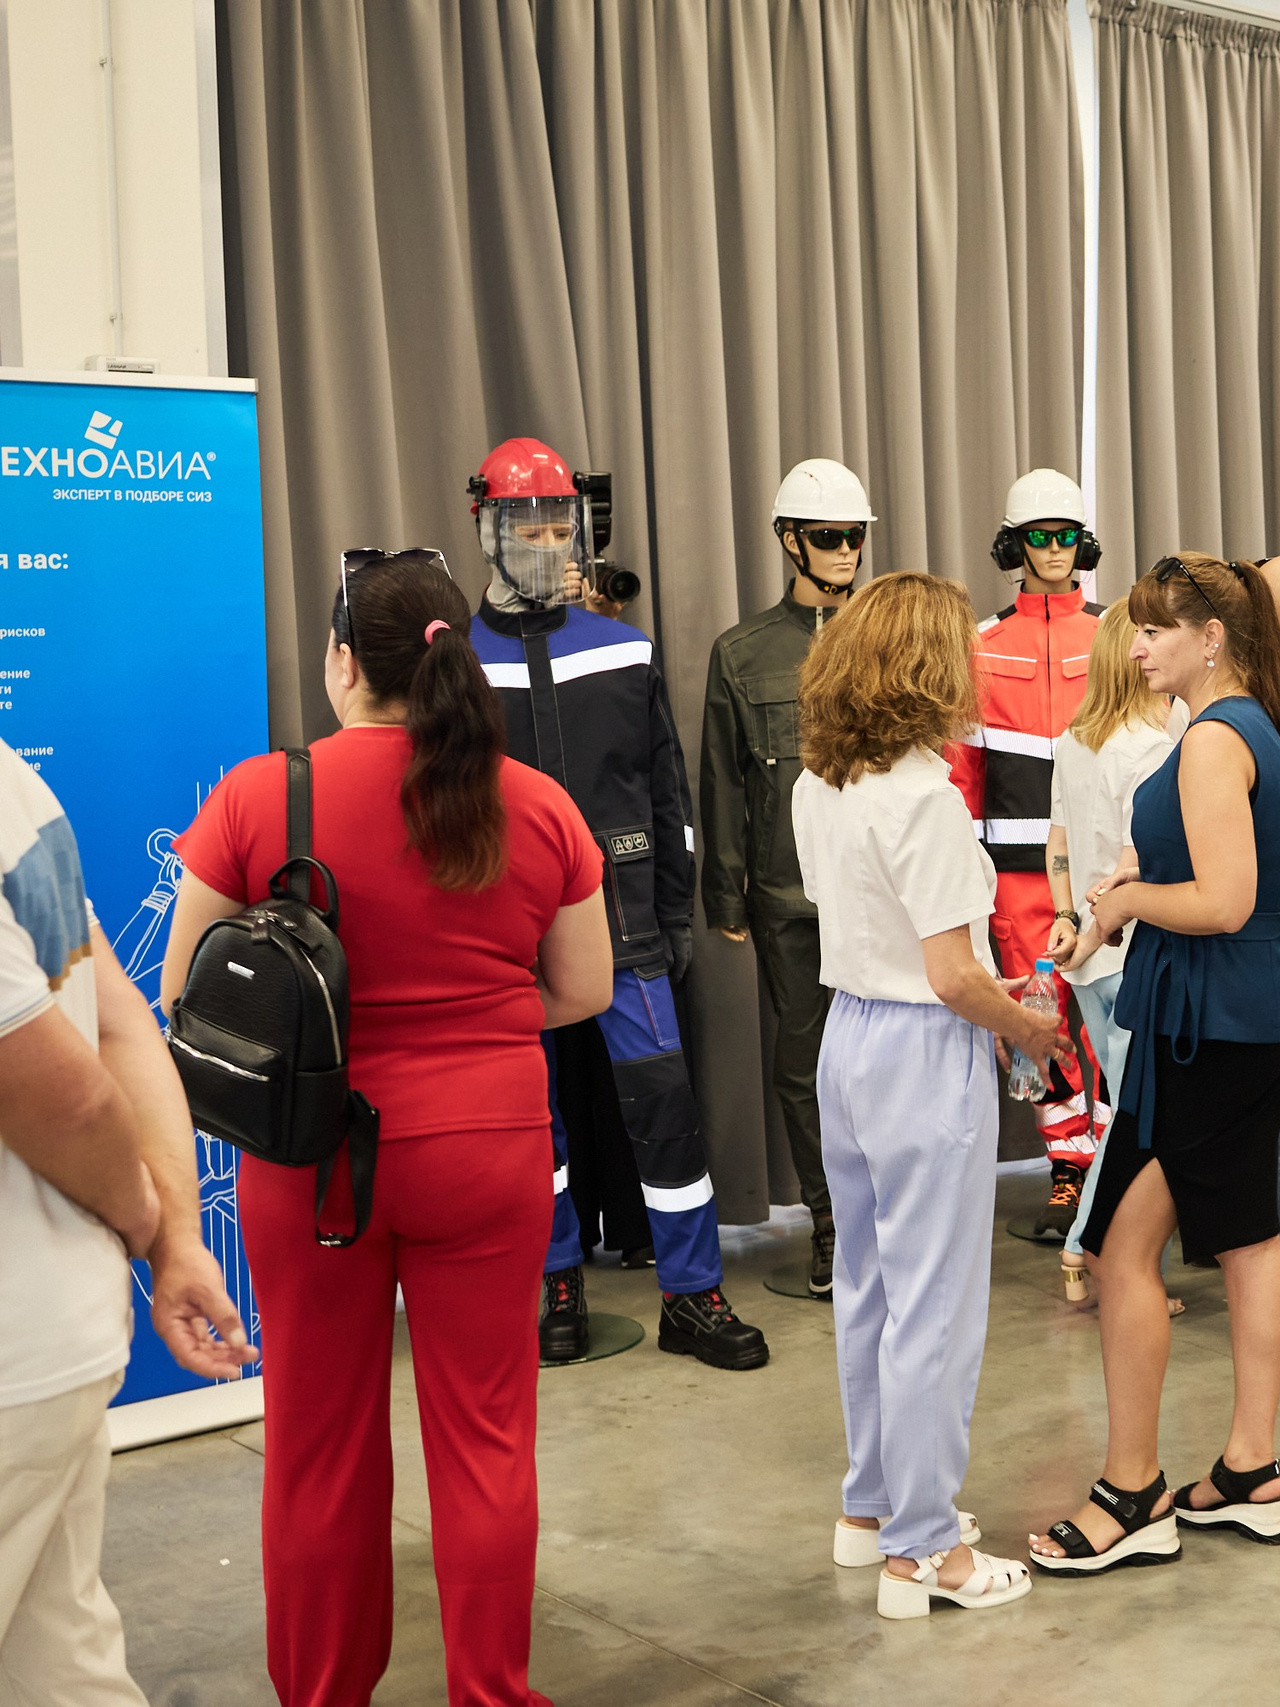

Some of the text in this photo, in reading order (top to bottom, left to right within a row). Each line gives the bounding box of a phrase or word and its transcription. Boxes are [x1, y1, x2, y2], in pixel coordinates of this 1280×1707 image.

[53, 489, 212, 503] ЭКСПЕРТ В ПОДБОРЕ СИЗ
[18, 553, 69, 570] вас:
[0, 627, 46, 640] рисков
[0, 669, 31, 679] ение
[15, 746, 54, 756] вание
